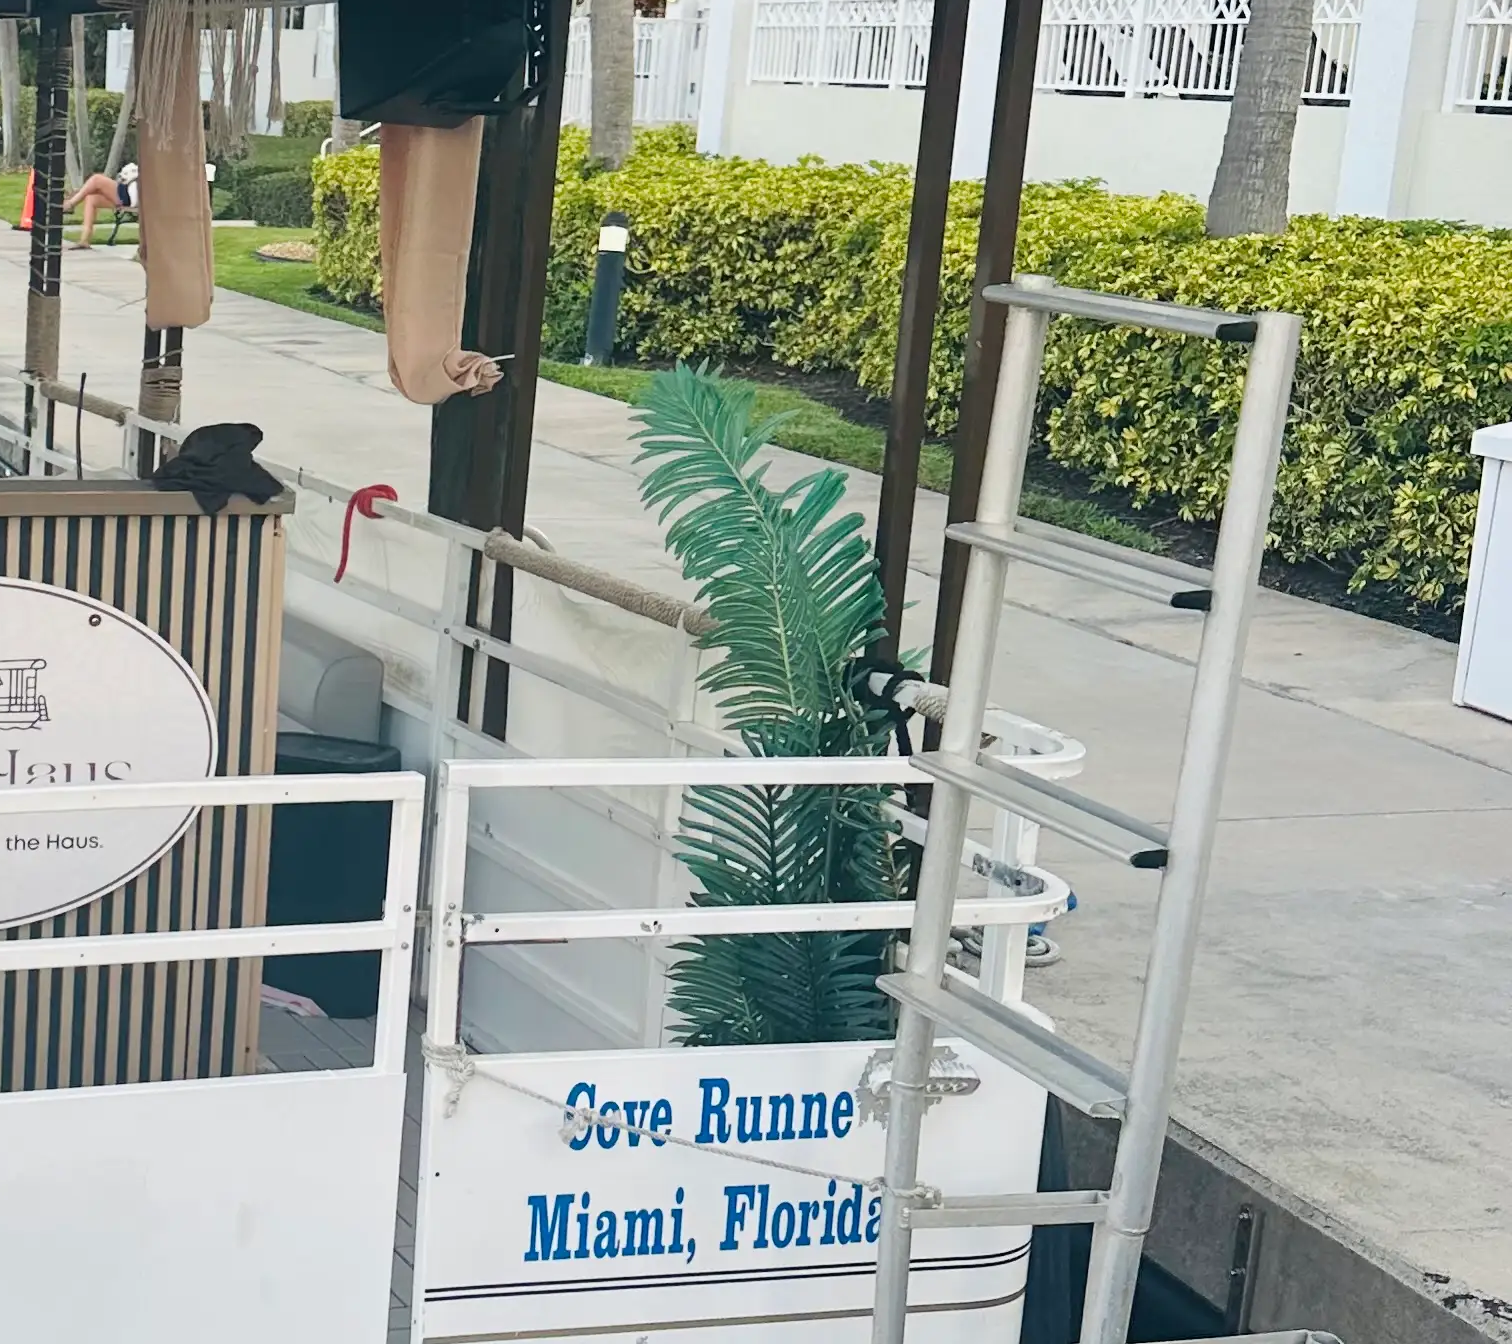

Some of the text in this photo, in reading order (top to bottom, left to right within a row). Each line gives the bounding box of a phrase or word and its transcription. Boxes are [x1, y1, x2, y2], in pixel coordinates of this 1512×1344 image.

[6, 834, 40, 851] the
[45, 833, 104, 851] Haus.
[565, 1081, 673, 1151] Cove
[524, 1178, 883, 1265] Miami, Florida
